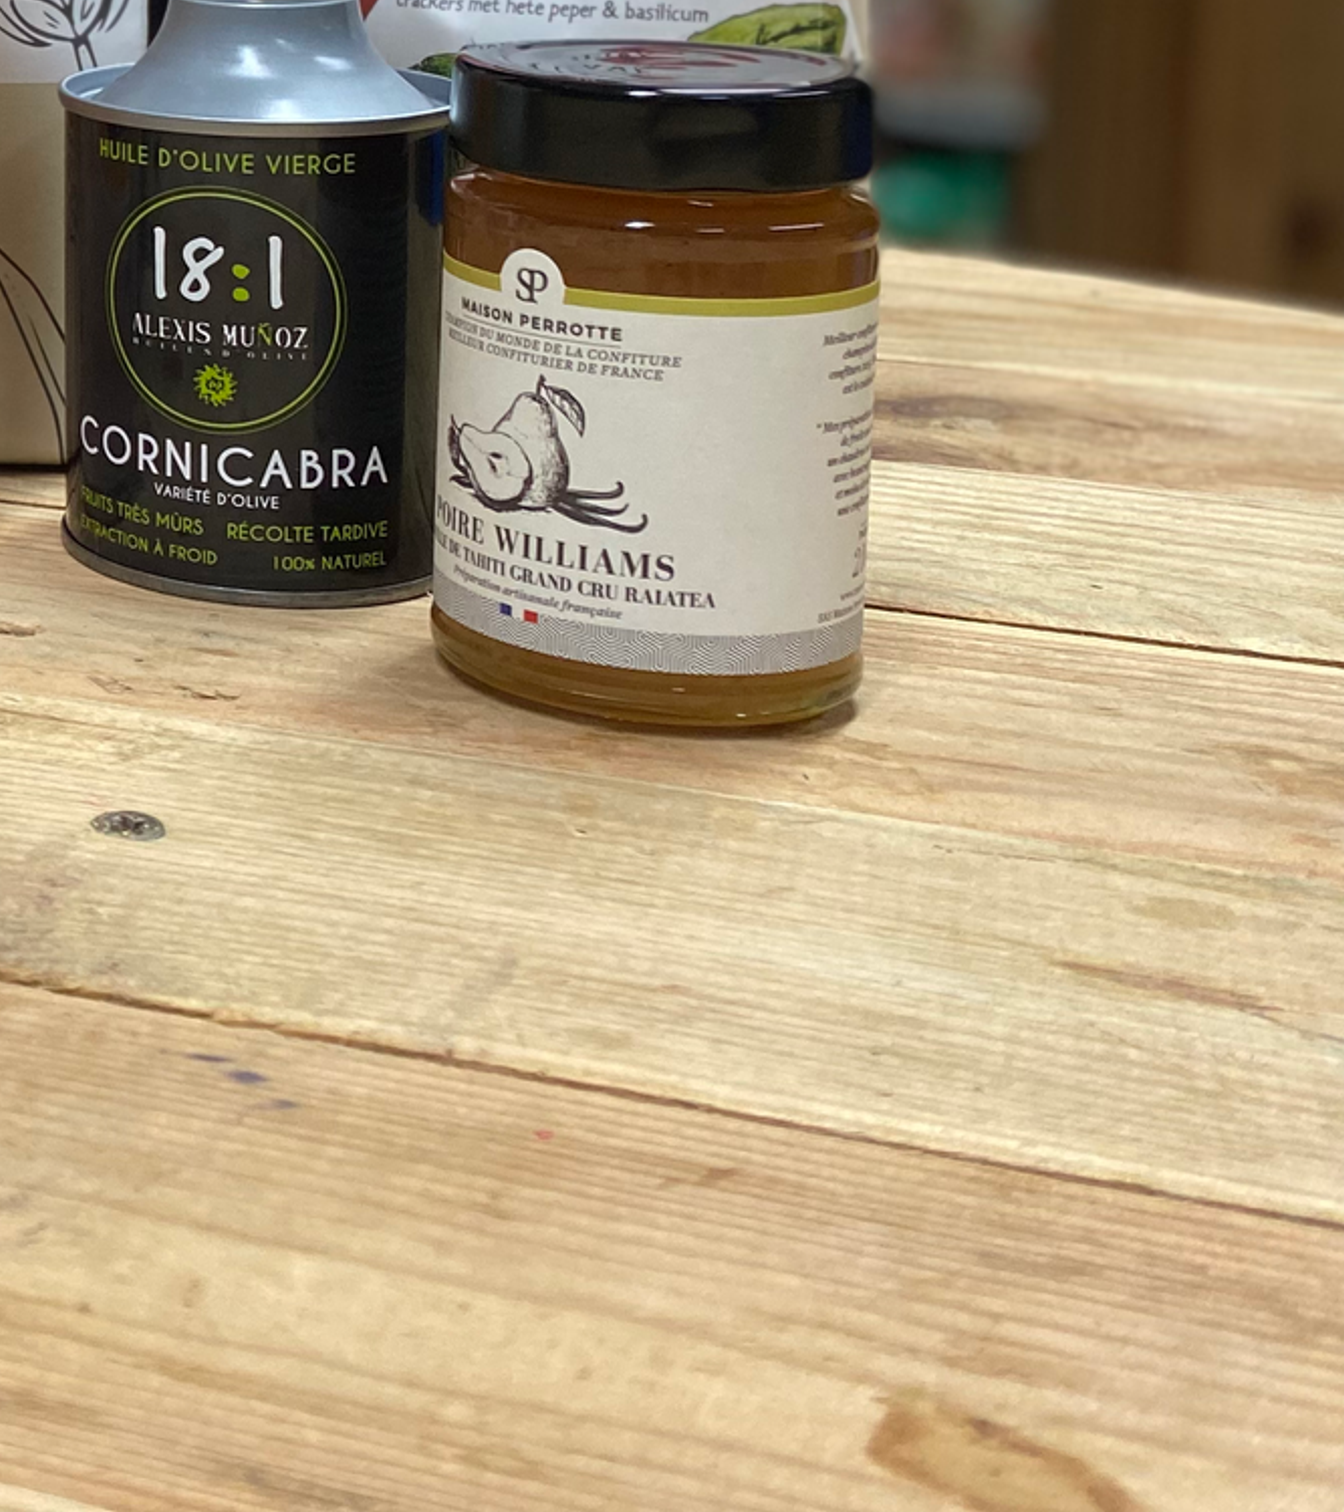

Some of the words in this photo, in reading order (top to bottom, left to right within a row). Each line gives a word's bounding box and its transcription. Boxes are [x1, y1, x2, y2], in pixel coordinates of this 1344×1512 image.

[548, 3, 597, 24] peper
[602, 0, 619, 18] &
[624, 2, 709, 23] basilicum
[99, 138, 148, 165] HUILE
[158, 147, 255, 174] D'OLIVE
[266, 153, 356, 175] VIERGE
[153, 225, 284, 310] 18:1
[132, 312, 212, 344] ALEXIS
[222, 322, 309, 349] MUÑOZ
[461, 296, 513, 324] MAISON
[519, 314, 623, 342] PERROTTE
[485, 342, 574, 371] CONFITURIER
[577, 360, 597, 374] DE
[601, 365, 664, 382] FRANCE
[496, 330, 541, 352] MONDE
[543, 341, 563, 356] DE
[565, 345, 584, 359] LA
[587, 349, 682, 368] CONFITURE
[80, 415, 389, 489] CORNICABRA
[82, 485, 113, 514] FRUITS
[117, 502, 150, 526] TRÈS
[156, 512, 204, 535] MÛRS
[153, 482, 211, 504] VARIÉTÉ
[217, 492, 280, 509] D'OLIVE
[81, 513, 148, 552] EXTRACTION
[168, 544, 218, 565] FROID
[227, 521, 315, 543] RÉCOLTE
[320, 520, 388, 542] TARDIVE
[437, 493, 485, 546] POIRE
[494, 524, 676, 582] WILLIAMS
[273, 556, 315, 571] 100%
[321, 550, 387, 570] NATUREL
[462, 545, 506, 577] TAHITI
[509, 563, 572, 594] GRAND
[577, 578, 618, 601] CRU
[624, 586, 716, 609] RAIATEA
